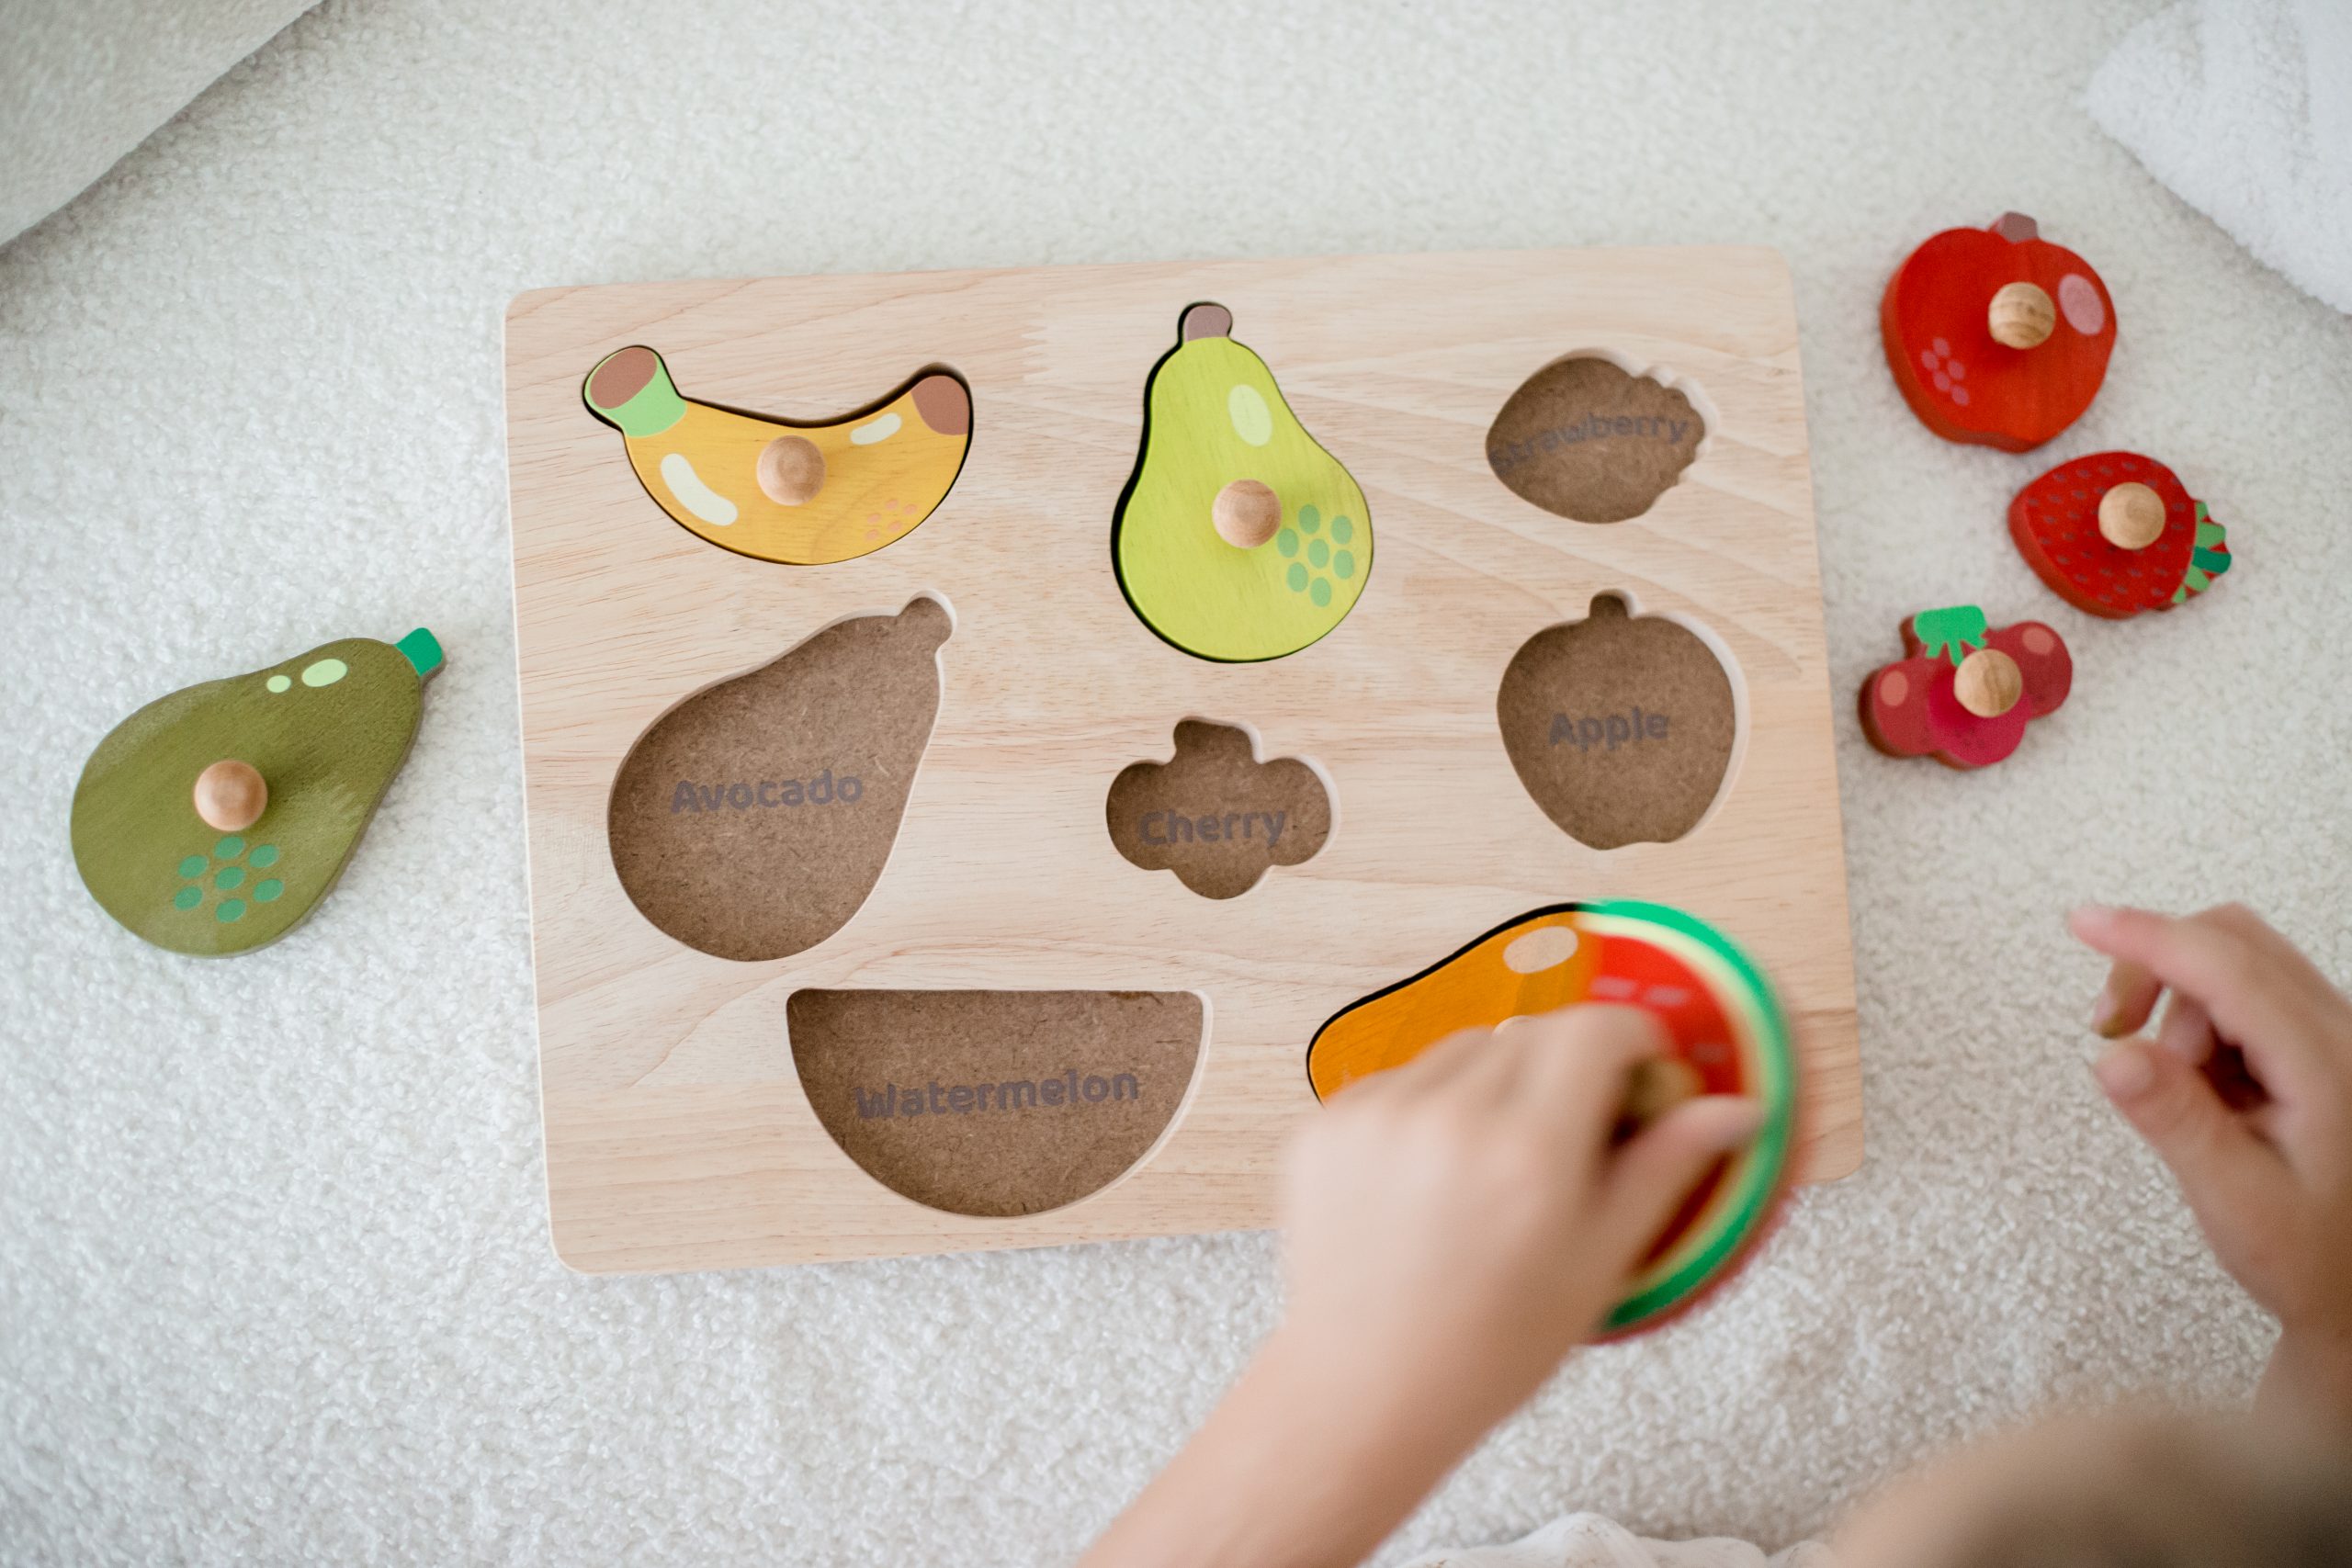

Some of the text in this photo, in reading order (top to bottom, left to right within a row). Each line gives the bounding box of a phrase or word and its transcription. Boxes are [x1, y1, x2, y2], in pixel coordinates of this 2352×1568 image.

[1549, 705, 1668, 752] Apple
[671, 768, 864, 814] Avocado
[1140, 808, 1285, 848] Cherry
[855, 1068, 1139, 1119] Watermelon
